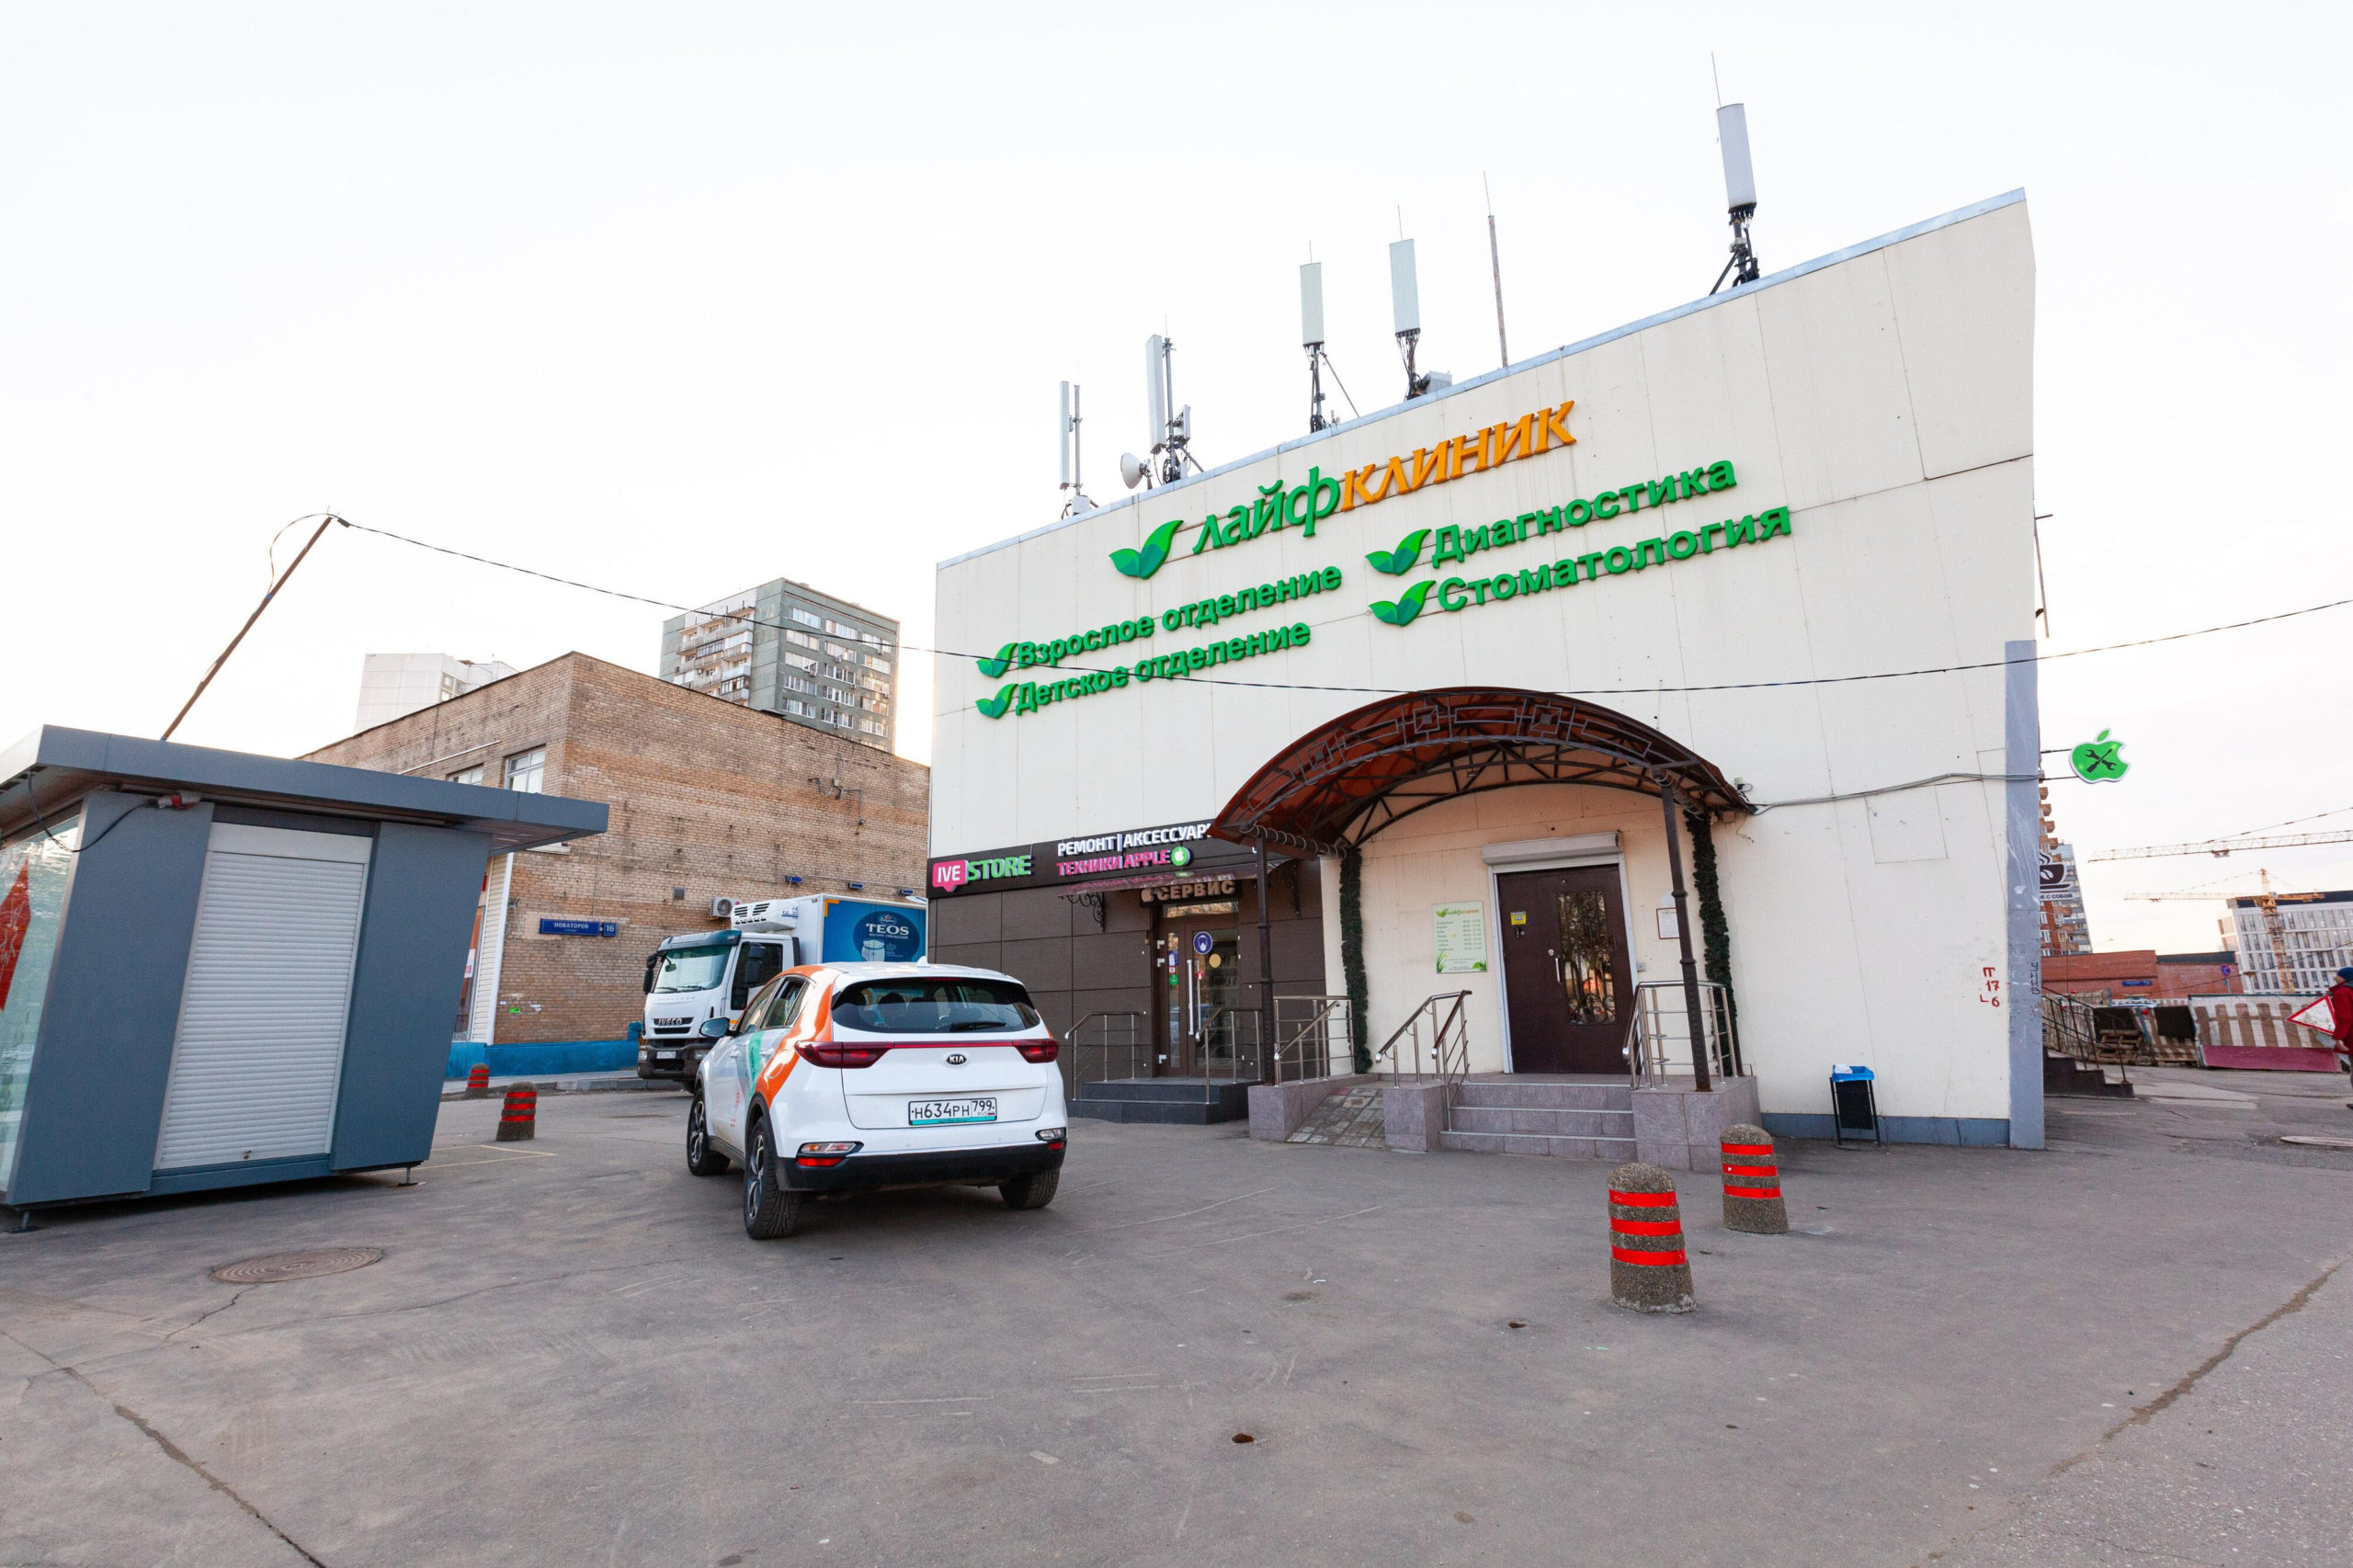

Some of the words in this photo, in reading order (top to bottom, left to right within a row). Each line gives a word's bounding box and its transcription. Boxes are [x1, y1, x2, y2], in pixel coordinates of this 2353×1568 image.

[1431, 460, 1737, 569] Диагностика
[1438, 506, 1792, 611] Стоматология
[1016, 616, 1155, 669] Взрослое
[1161, 565, 1342, 631] отделение
[1014, 665, 1129, 715] Детское
[1133, 621, 1311, 681] отделение
[1058, 835, 1117, 857] РЕМОНТ
[968, 855, 1031, 881] STORE
[1056, 856, 1123, 876] ТЕХНИКИ
[1123, 849, 1171, 868] APPLE
[1157, 881, 1235, 901] СЕРВИС
[866, 923, 909, 936] TEOS
[658, 1017, 683, 1027] IVECO
[949, 1055, 964, 1063] KIA
[972, 1100, 993, 1111] 799
